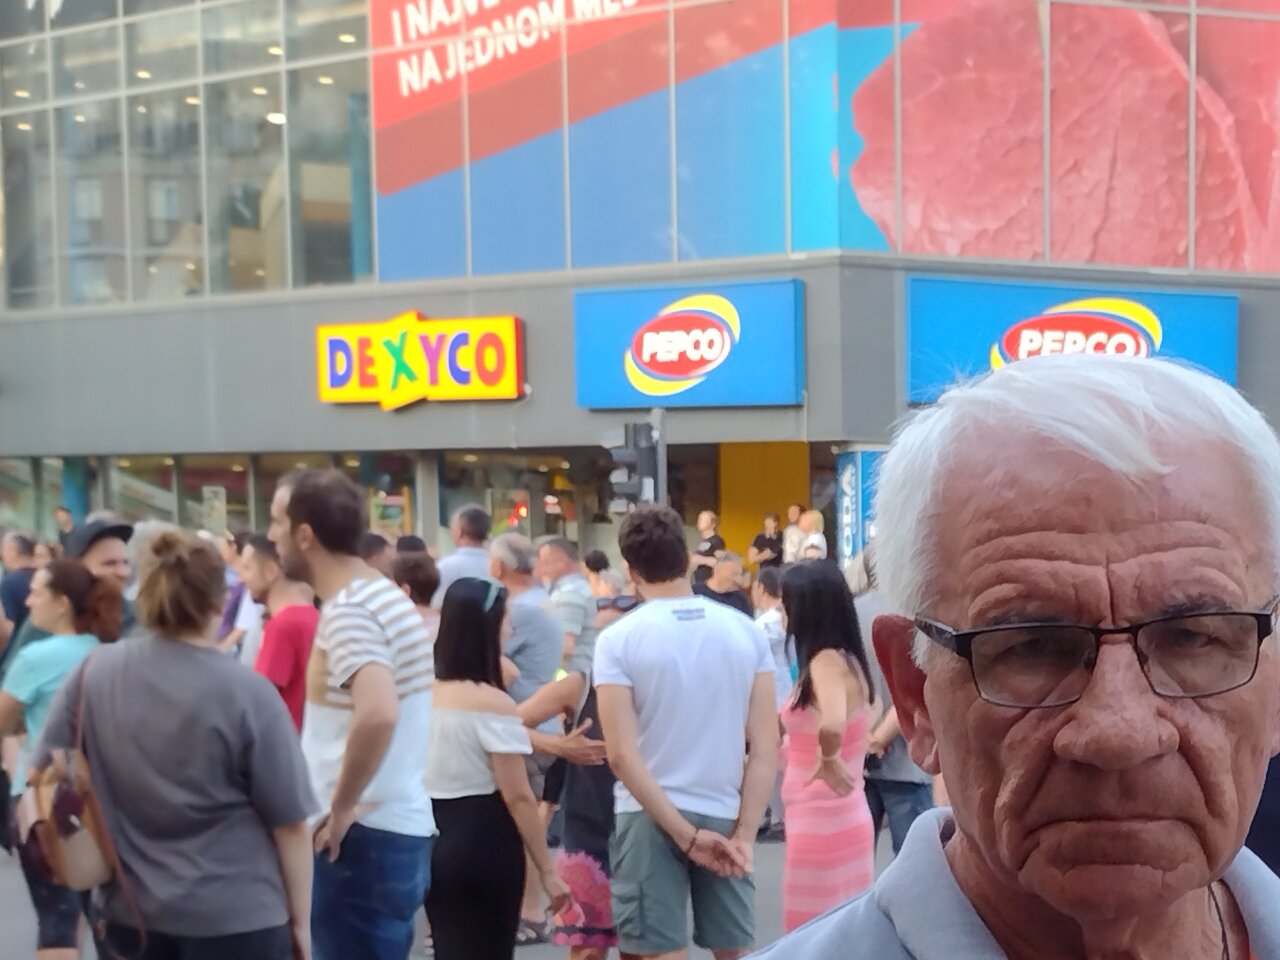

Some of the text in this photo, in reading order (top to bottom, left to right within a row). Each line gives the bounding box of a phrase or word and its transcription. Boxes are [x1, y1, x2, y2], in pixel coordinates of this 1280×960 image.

[327, 331, 507, 390] DEXYCO
[642, 327, 724, 363] PEPCO
[1017, 328, 1137, 361] PEPCO
